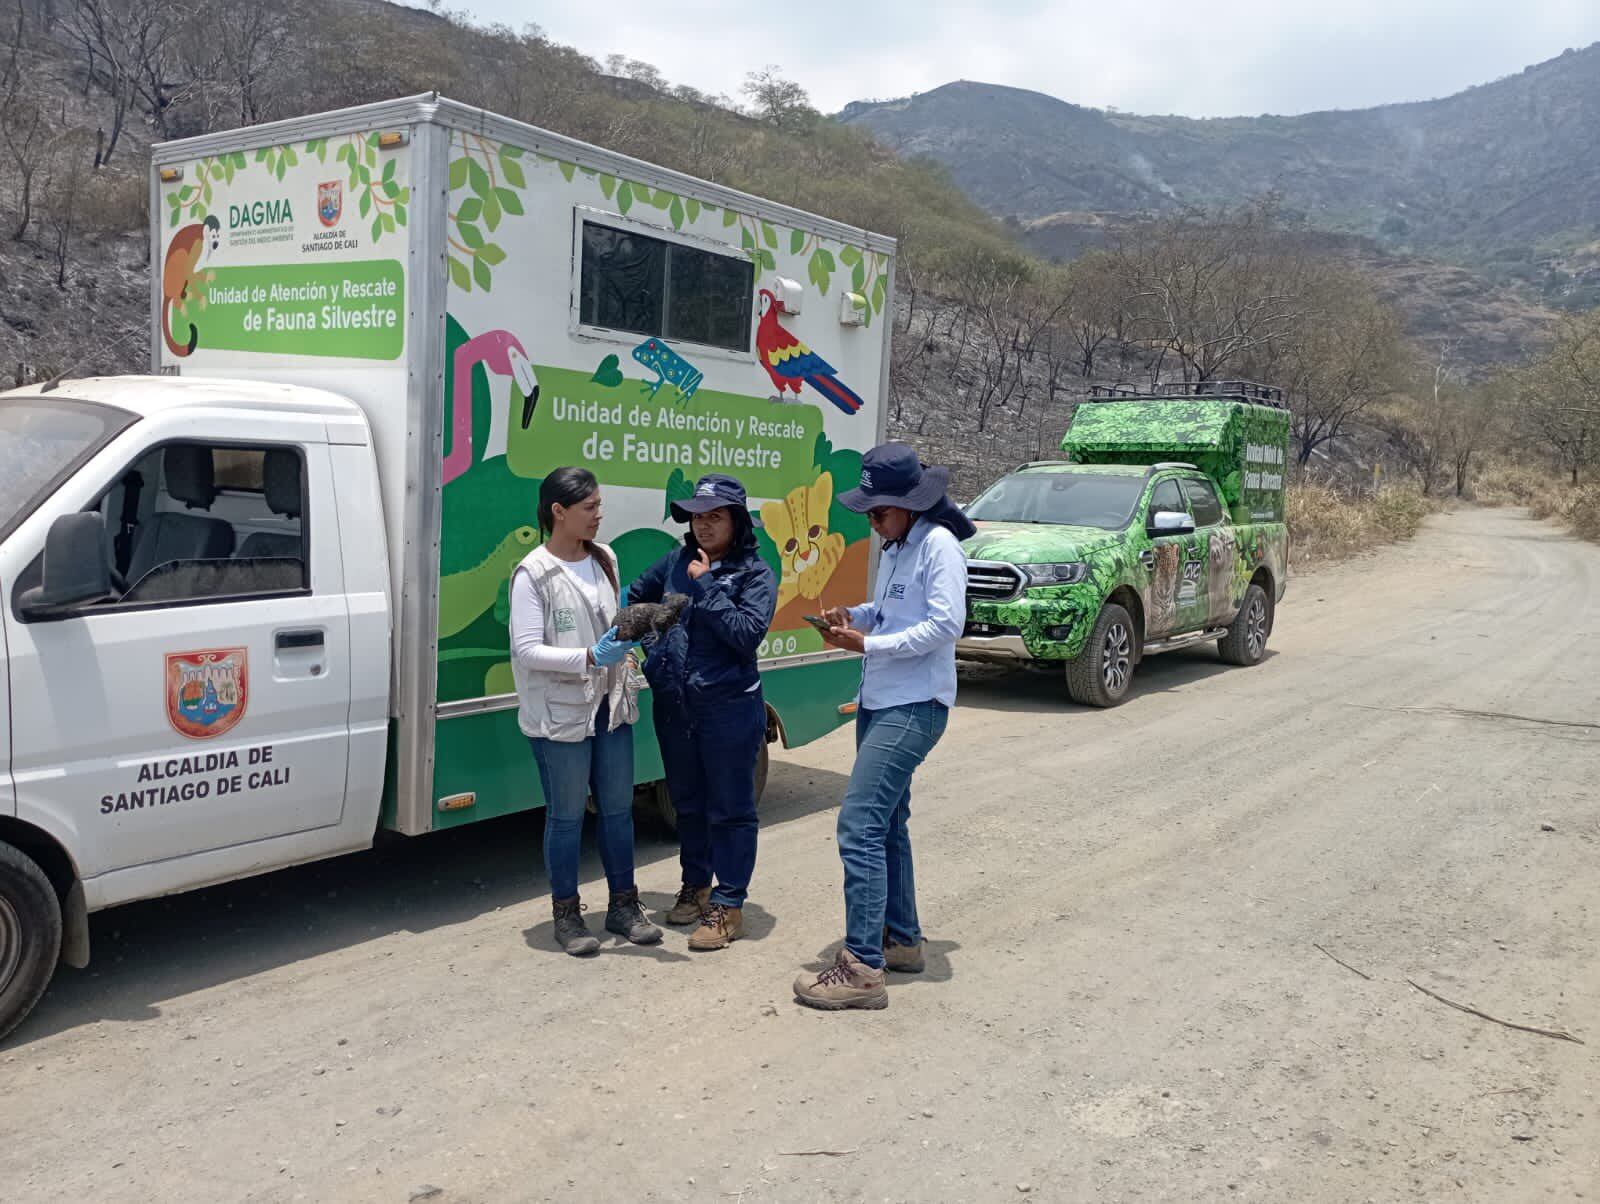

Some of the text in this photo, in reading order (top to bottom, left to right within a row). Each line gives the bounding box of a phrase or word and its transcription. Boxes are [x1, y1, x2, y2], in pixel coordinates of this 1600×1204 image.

[229, 198, 293, 229] DAGMA
[302, 239, 358, 252] SANTIAGO DE CALI
[338, 230, 346, 239] DE
[209, 278, 396, 304] Unidad de Atención y Rescate
[243, 304, 396, 331] de Fauna Silvestre
[552, 397, 804, 439] Unidad de Atención y Rescate
[582, 432, 782, 469] de Fauna Silvestre
[1184, 563, 1200, 579] CVC
[137, 746, 273, 783] ALCALDIA DE
[100, 767, 290, 815] SANTIAGO DE CALI
